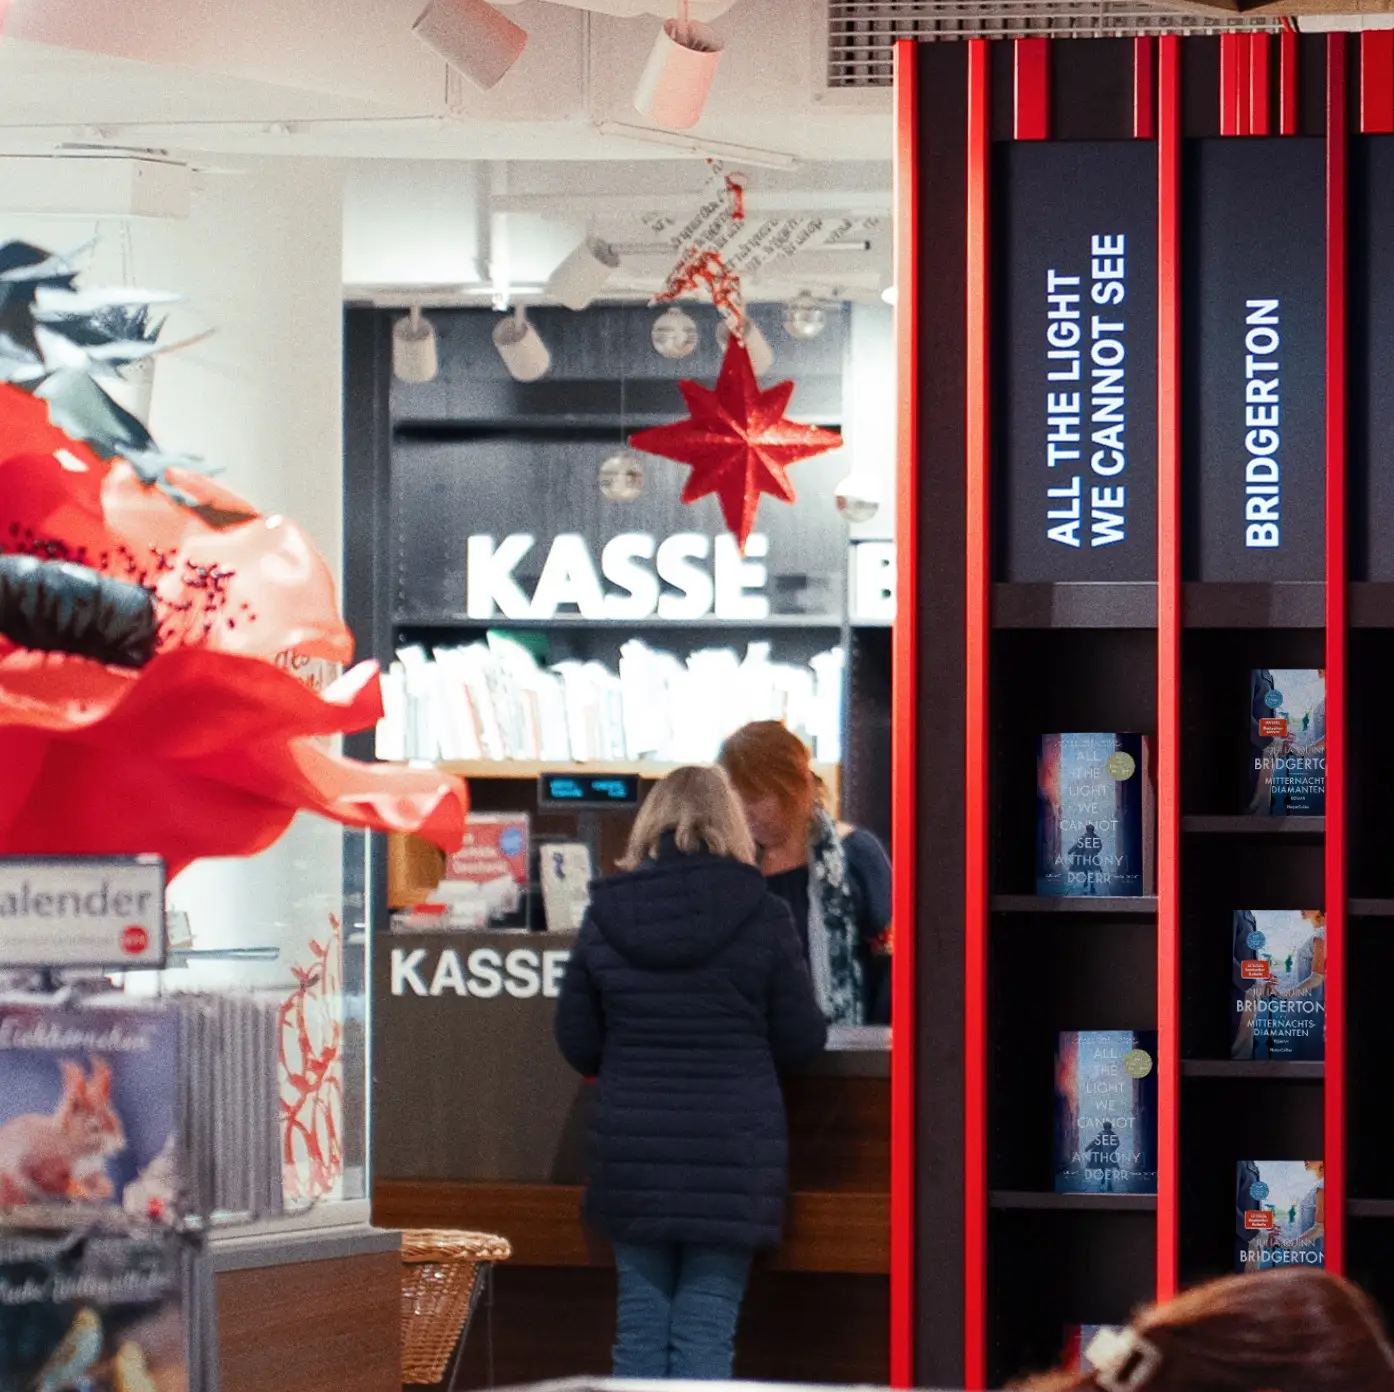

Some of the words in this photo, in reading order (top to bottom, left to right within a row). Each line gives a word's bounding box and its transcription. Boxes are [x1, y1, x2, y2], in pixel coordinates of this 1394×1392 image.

[1091, 234, 1125, 305] SEE
[1046, 269, 1081, 381] LIGHT
[1090, 315, 1125, 476] CANNOT
[1047, 392, 1080, 467] THE
[1245, 299, 1280, 548] BRIDGERTON
[1047, 476, 1080, 548] ALL
[1091, 486, 1125, 547] WE
[467, 533, 770, 620] KASSE
[1076, 751, 1101, 762] ALL
[1074, 768, 1100, 778] THE
[1069, 785, 1107, 796] LIGHT
[1271, 785, 1325, 794] DIAMANTEN
[1078, 802, 1099, 814] WE
[1060, 820, 1119, 831] CANNOT
[1077, 837, 1101, 849] SEE
[1054, 855, 1124, 866] ANTHONY
[1067, 872, 1112, 884] DOERR
[391, 948, 570, 998] KASSE
[1236, 1000, 1325, 1013] BRIDGERTON
[1247, 1019, 1317, 1028] MITTERNACHTS-
[1253, 1028, 1309, 1037] DIAMANTEN
[1093, 1047, 1118, 1058] ALL
[1086, 1082, 1125, 1094] LIGHT
[1095, 1100, 1115, 1111] WE
[1077, 1117, 1135, 1129] CANNOT
[1094, 1134, 1118, 1146] SEE
[1071, 1152, 1141, 1163] ANTHONY
[1083, 1169, 1129, 1181] DOERR
